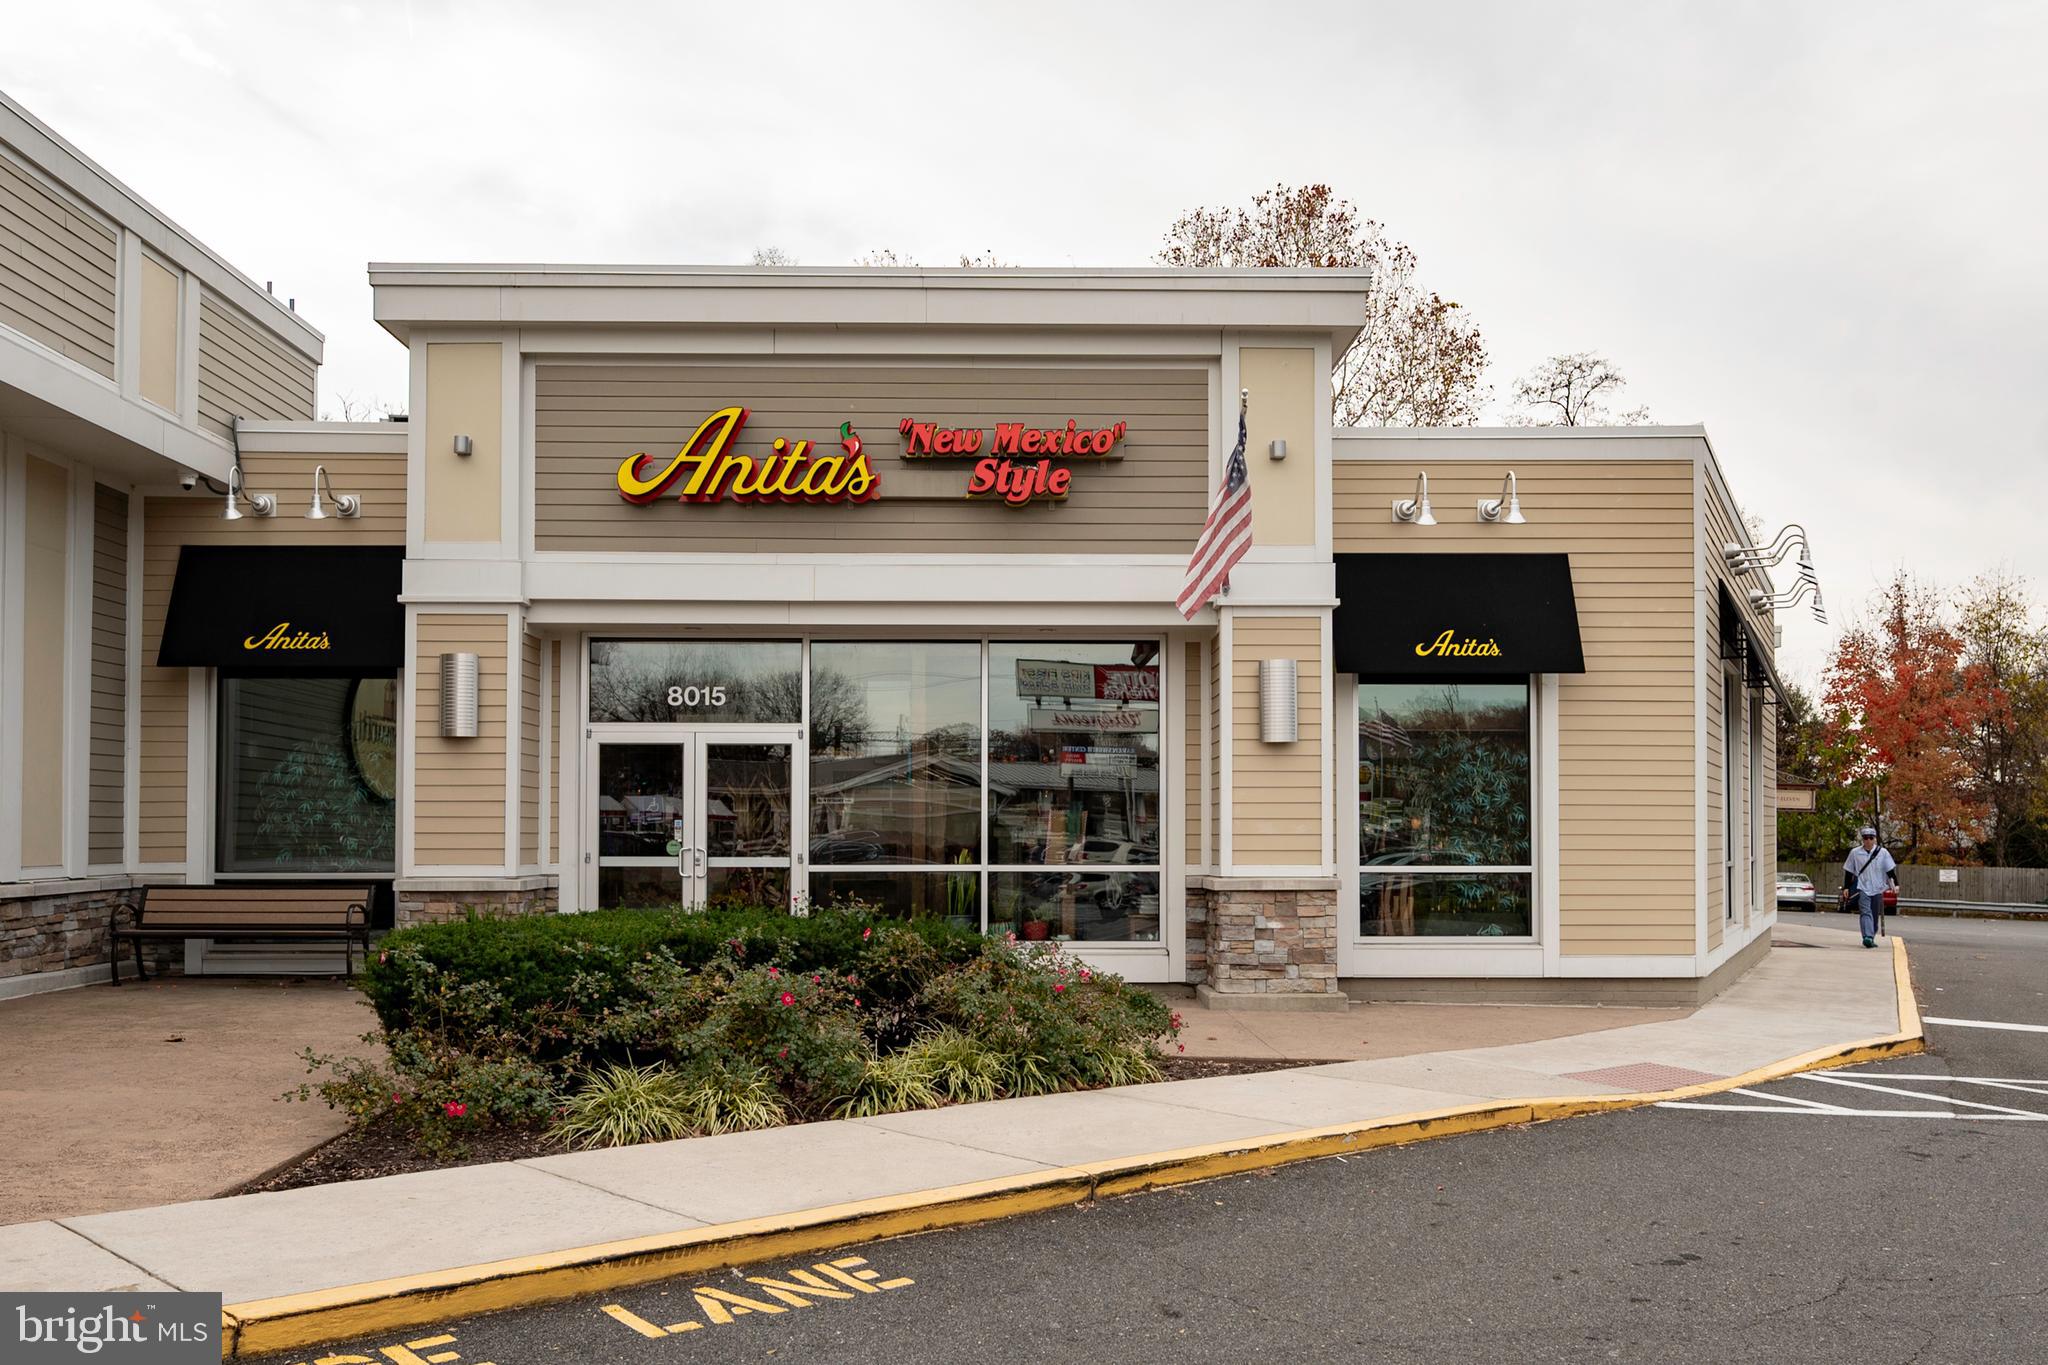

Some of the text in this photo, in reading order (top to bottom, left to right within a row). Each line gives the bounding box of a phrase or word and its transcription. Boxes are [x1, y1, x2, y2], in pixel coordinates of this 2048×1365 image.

[617, 406, 878, 500] Anita's
[899, 418, 1127, 455] "New Mexico"
[968, 458, 1072, 507] Style
[243, 622, 330, 650] Anita's
[1415, 629, 1502, 657] Anita's
[667, 686, 726, 707] 8015
[602, 1254, 915, 1339] LANE
